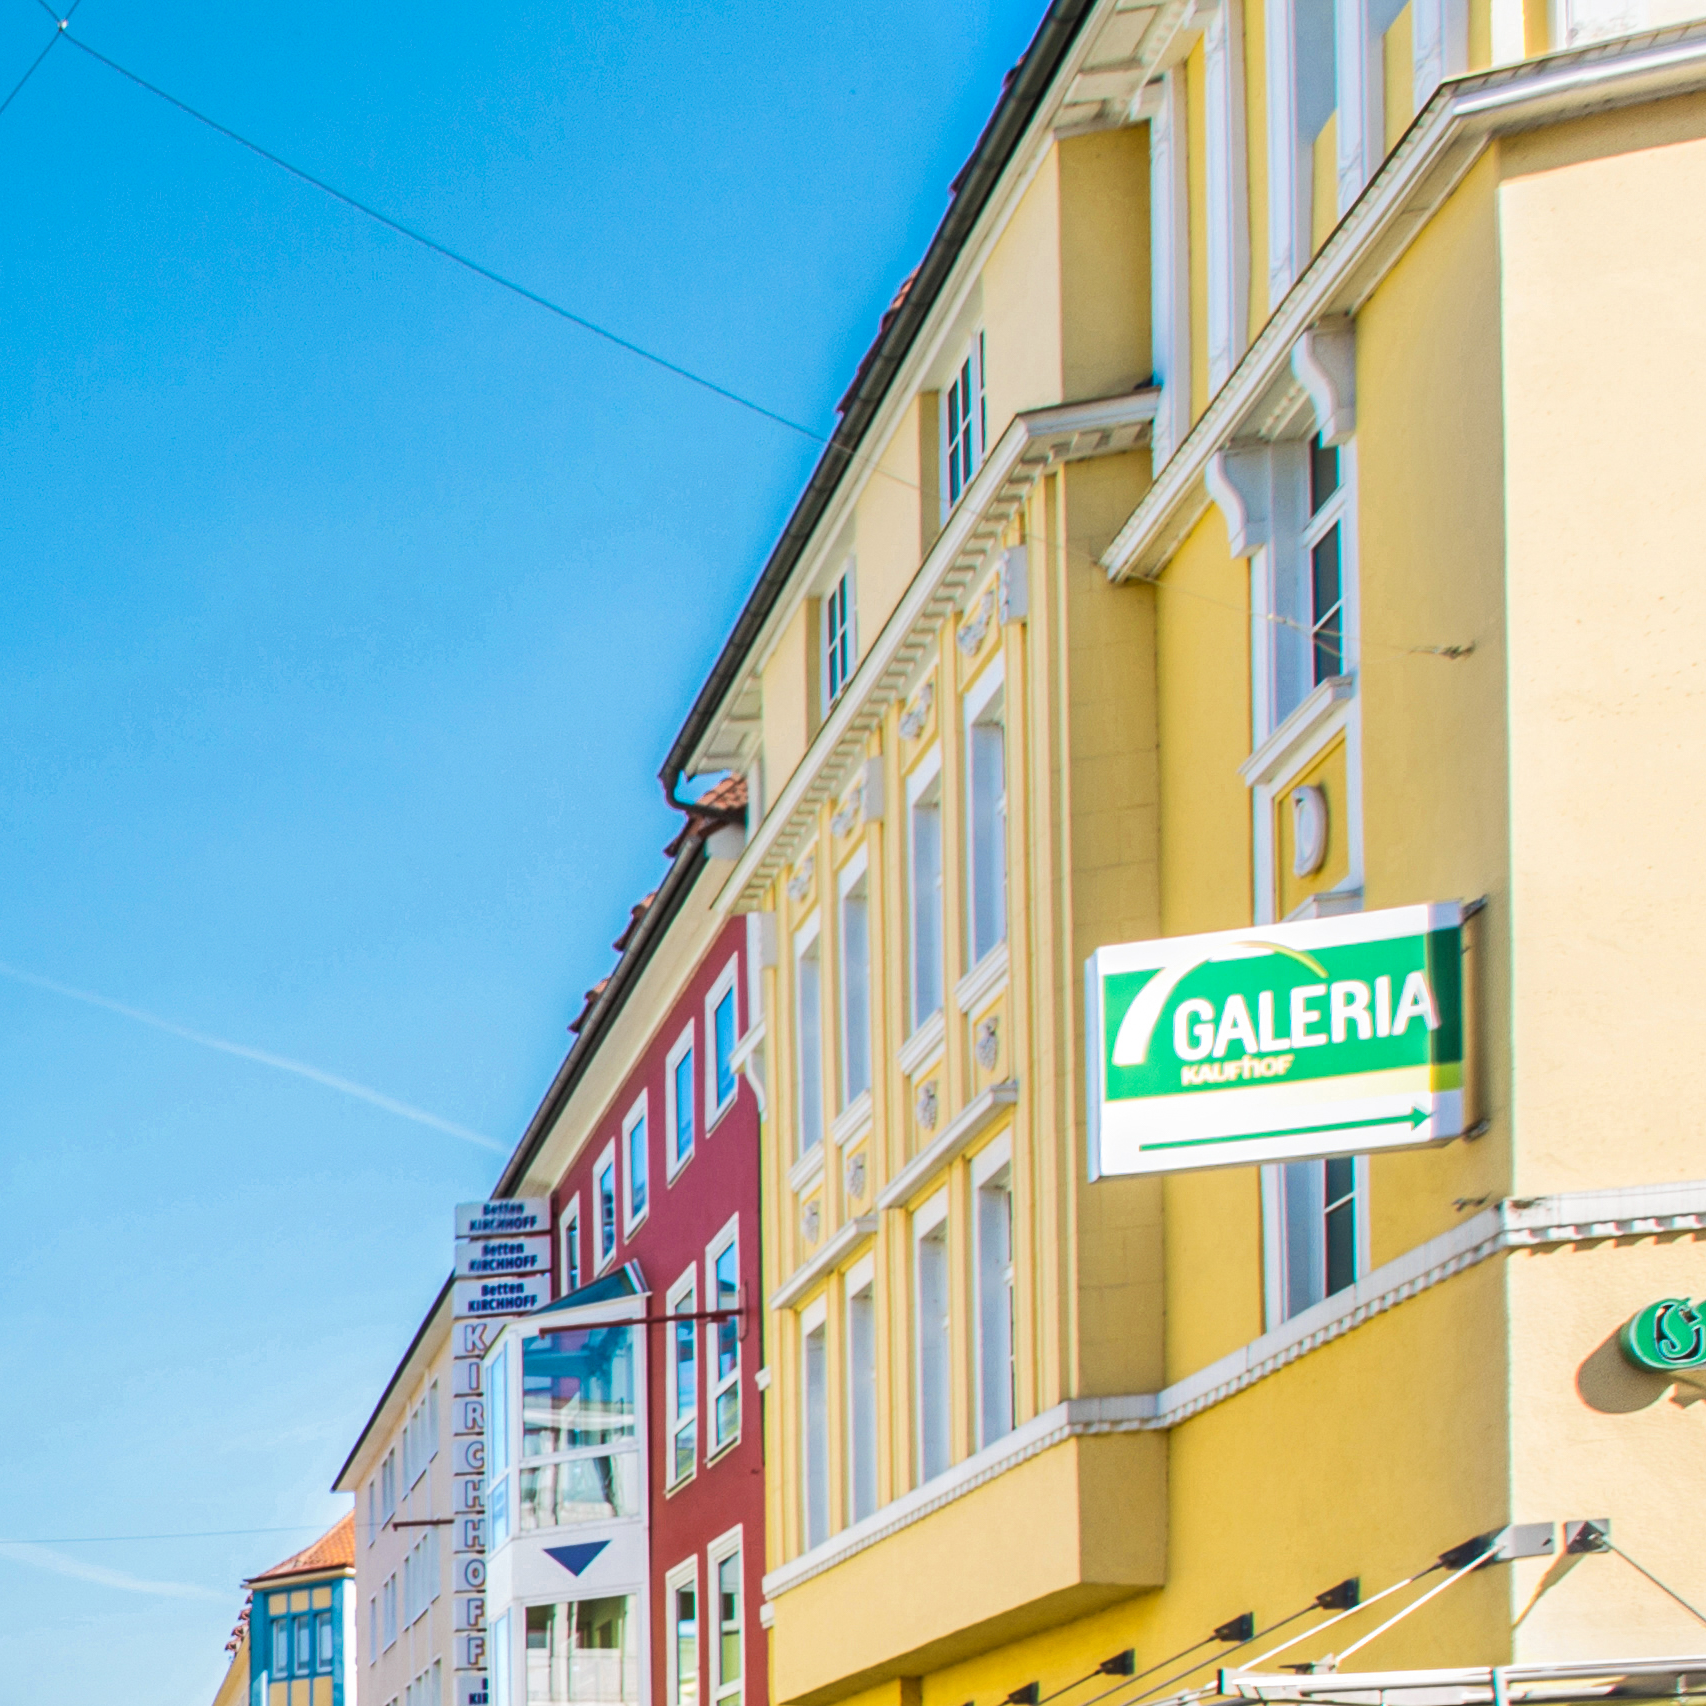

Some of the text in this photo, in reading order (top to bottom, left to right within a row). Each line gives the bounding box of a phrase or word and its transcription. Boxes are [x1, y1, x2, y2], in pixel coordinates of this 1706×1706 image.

[1173, 970, 1441, 1062] GALERIA
[483, 1203, 525, 1216] Betten
[469, 1215, 537, 1232] KIRCHHOFF
[482, 1243, 525, 1257] Betten
[468, 1254, 538, 1272] KIRCHHOFF
[481, 1282, 525, 1297] Betten
[468, 1294, 538, 1312] KIRCHHOFF
